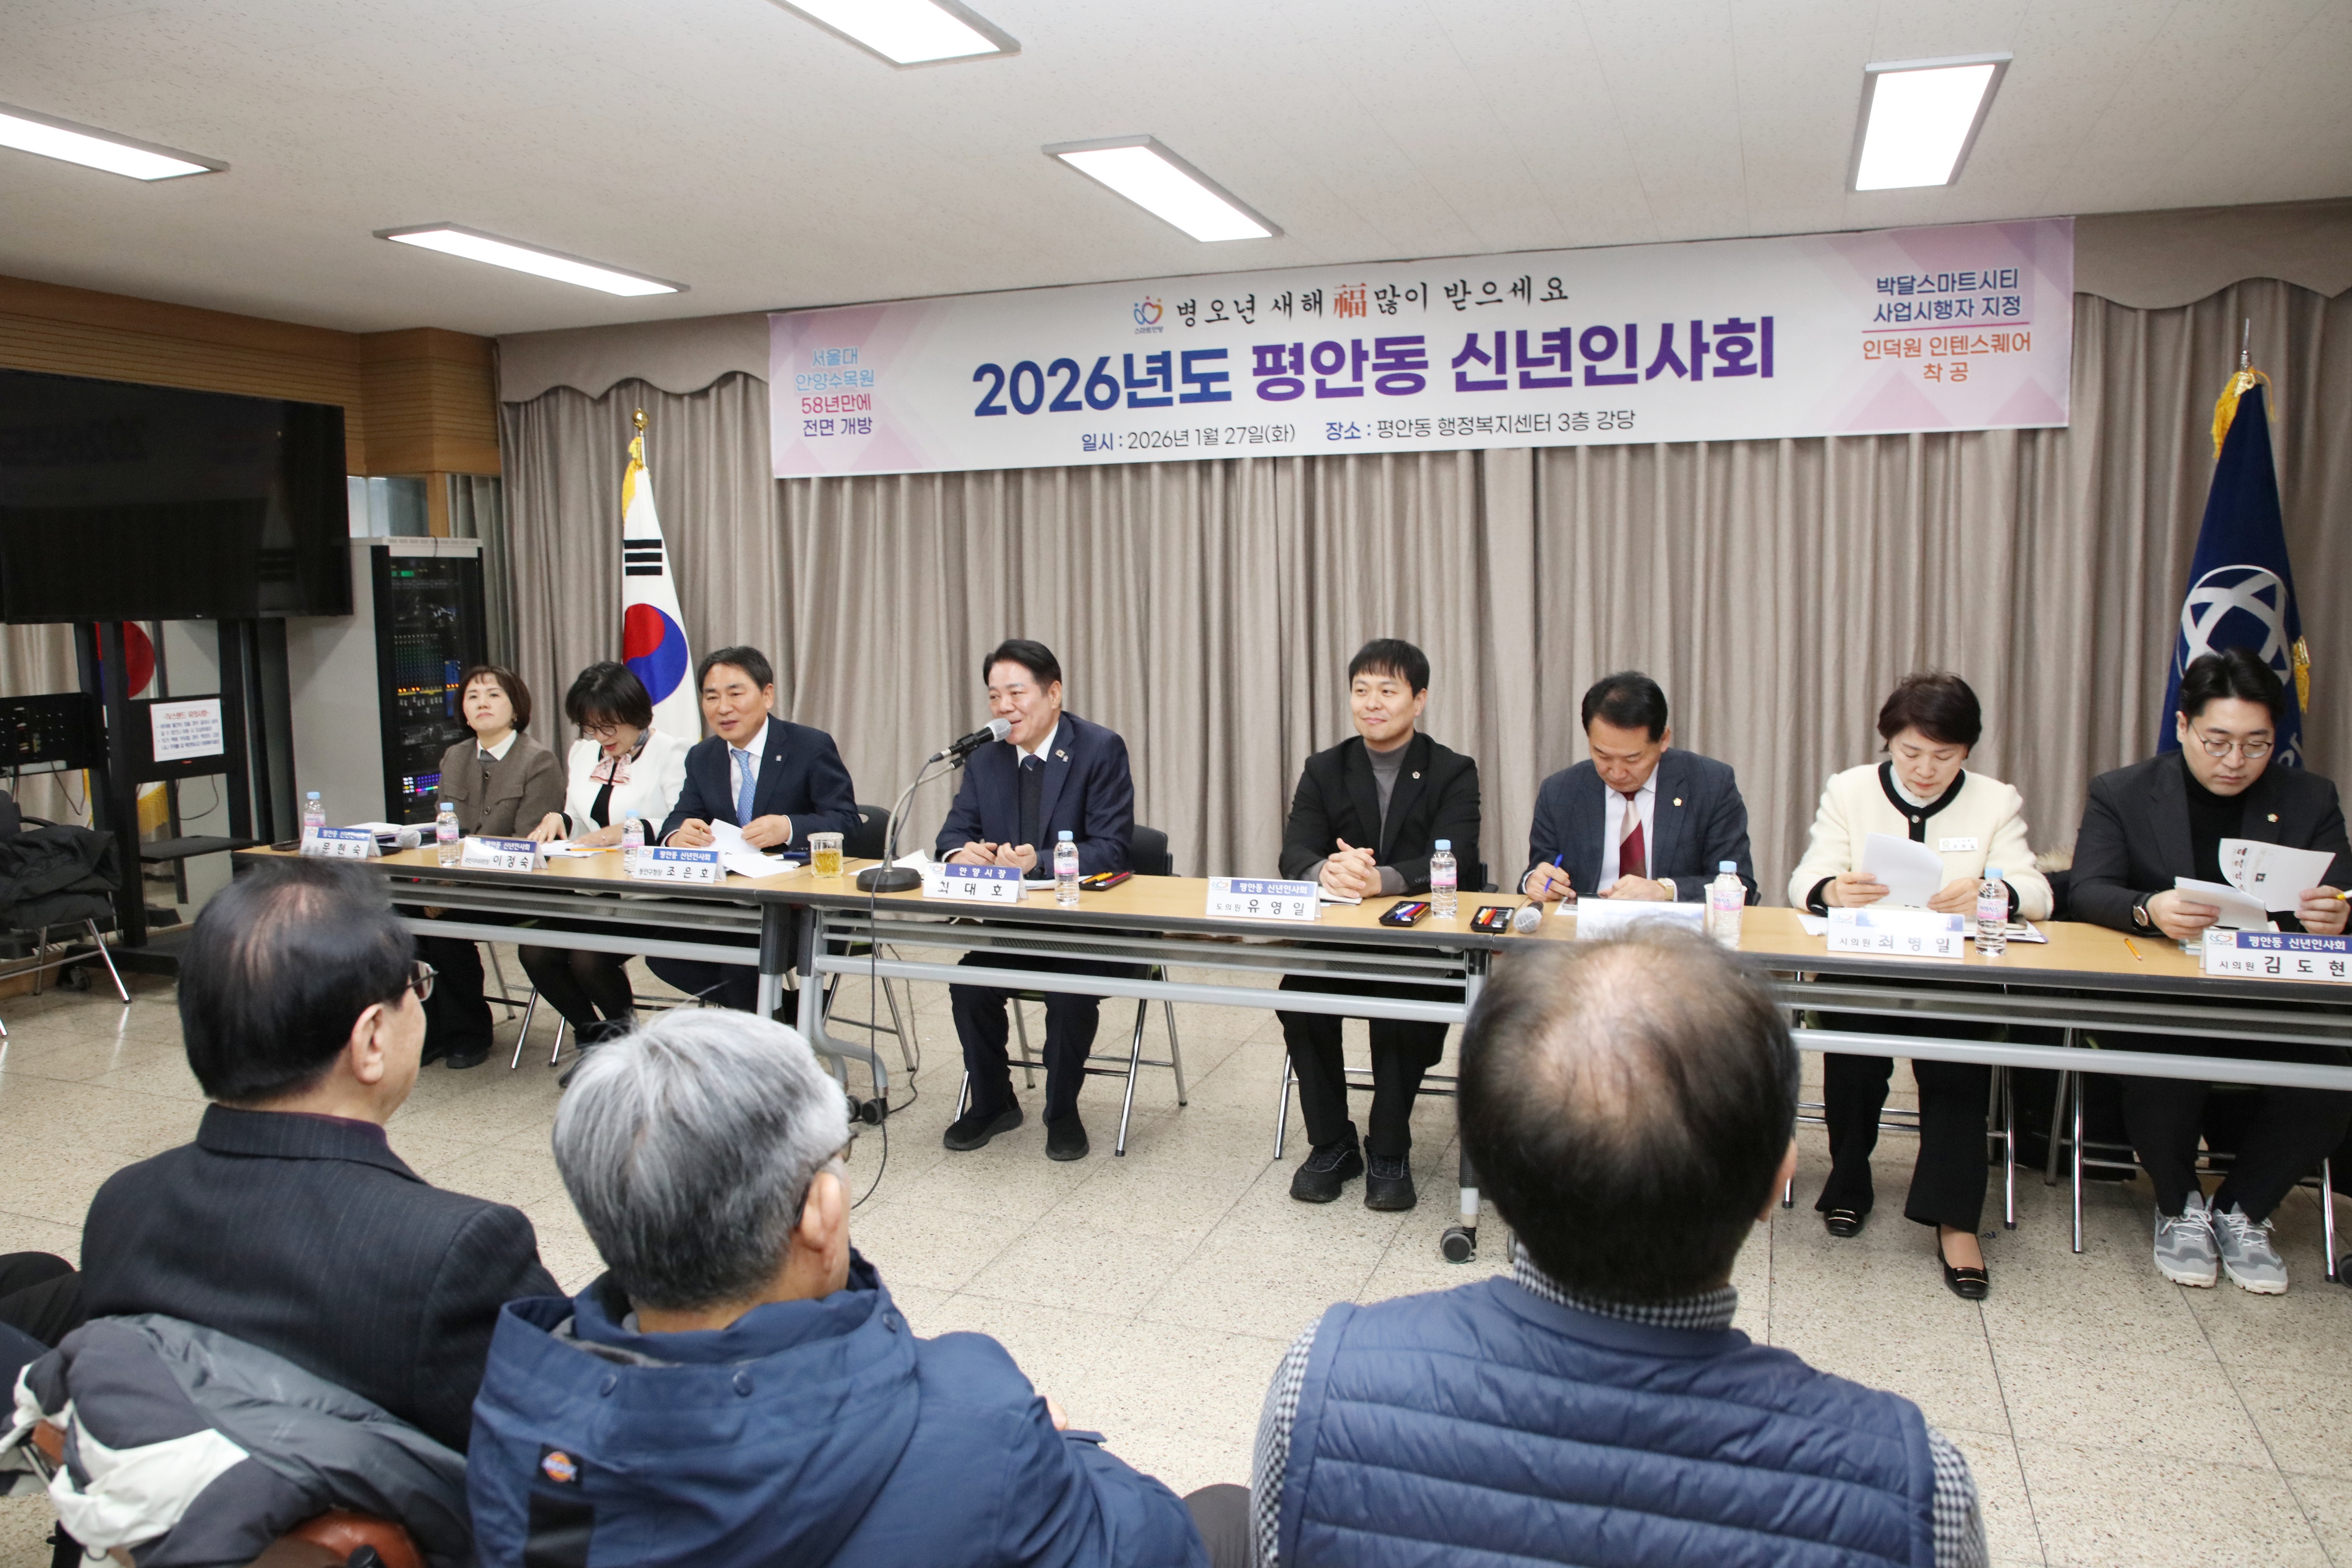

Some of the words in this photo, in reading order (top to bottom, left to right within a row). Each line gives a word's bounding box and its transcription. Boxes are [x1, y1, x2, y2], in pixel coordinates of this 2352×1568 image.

[1877, 268, 2020, 296] 박달스마트시티
[1271, 288, 1323, 321] 새해
[1333, 283, 1368, 319] 福
[1374, 281, 1428, 316] 많이
[1443, 275, 1568, 312] 받으세요
[1873, 299, 1974, 323] 사업시행자
[1982, 296, 2021, 317] 지정
[1863, 337, 1922, 360] 인덕원
[1929, 331, 2031, 357] 인텐스퀘어
[812, 347, 858, 367] 서울대
[972, 348, 1232, 417] 2026년도
[1252, 335, 1429, 401] 평안동
[1452, 316, 1774, 392] 신년인사회
[796, 369, 874, 391] 안양수목원
[802, 393, 871, 414] 58년만에
[804, 419, 834, 437] 전면
[841, 416, 873, 434] 개방
[1377, 418, 1432, 439] 평안동
[1438, 413, 1551, 436] 행정복지센터
[1558, 411, 1590, 432] 3층
[1597, 410, 1636, 430] 강당
[1127, 429, 1189, 449] 2026년
[1194, 428, 1218, 446] 1월
[1225, 423, 1296, 445] 27일(화)
[503, 842, 531, 851] 신년인사회
[659, 851, 678, 860] 평안동
[680, 852, 711, 861] 신년인사회
[639, 868, 662, 876] 동안구청장
[1239, 882, 1264, 893] 평안동
[1267, 884, 1308, 894] 신년인사회
[2248, 936, 2283, 948] 평안동
[2288, 938, 2346, 951] 신년인사회
